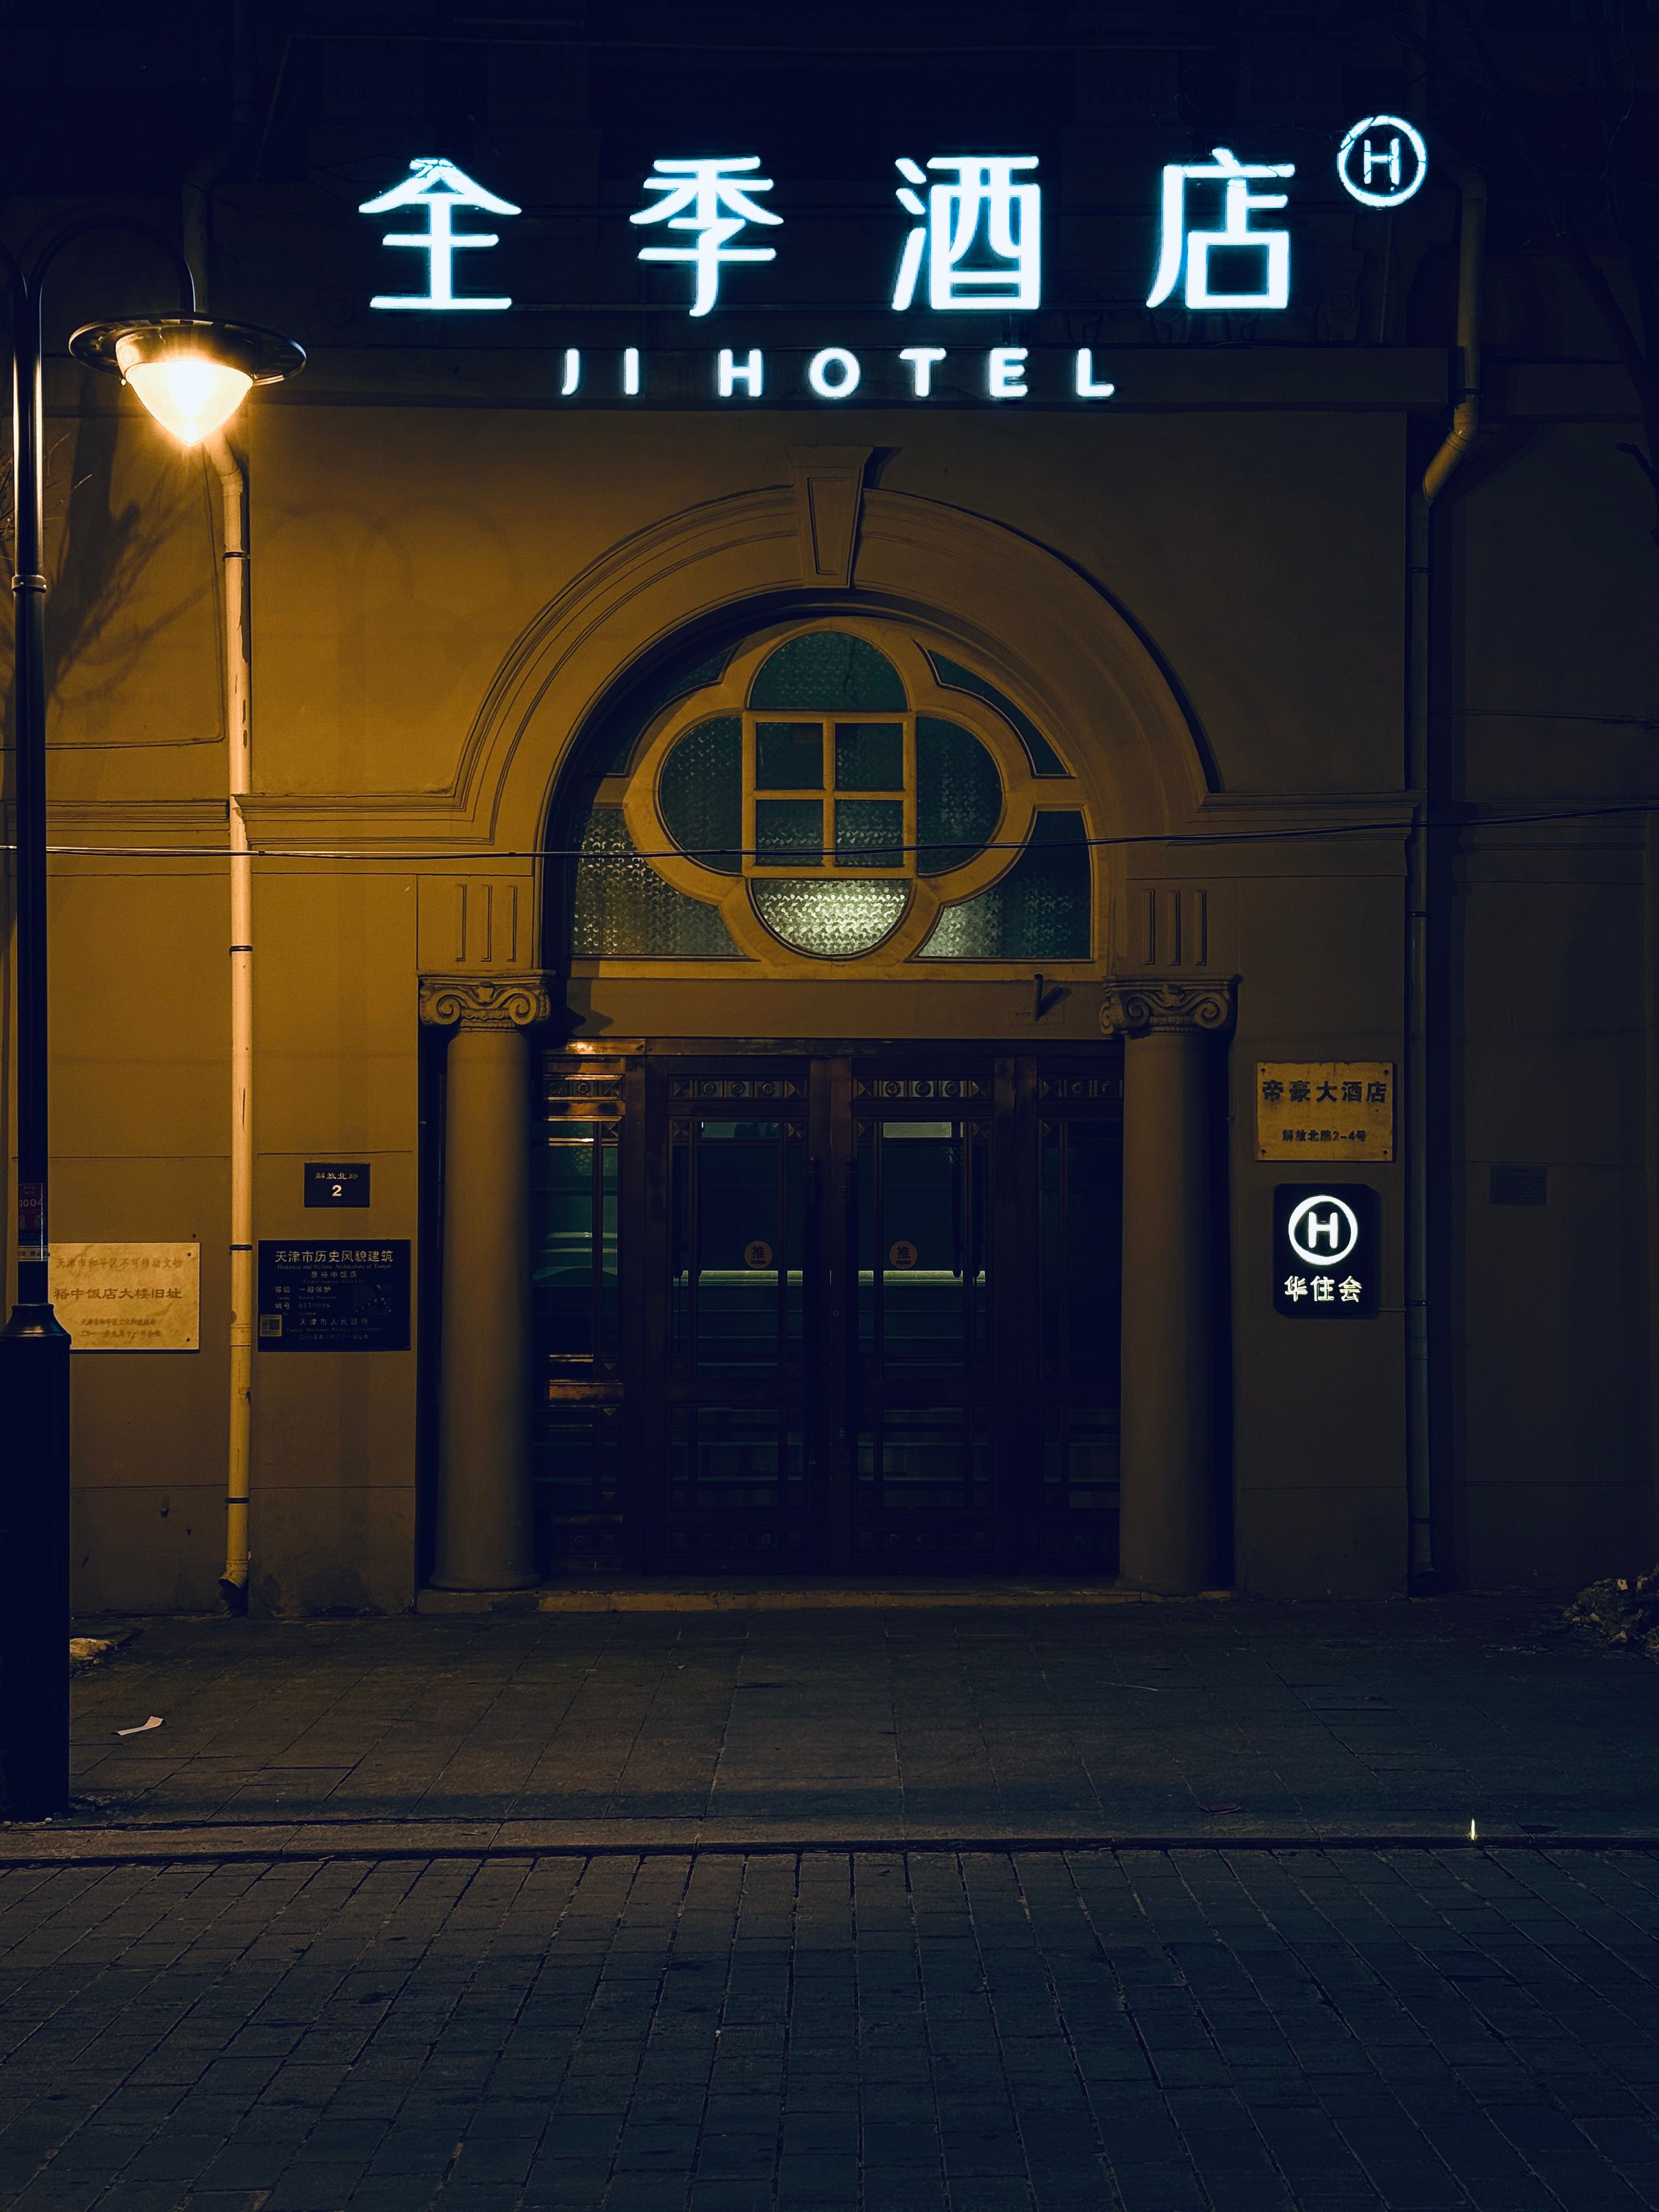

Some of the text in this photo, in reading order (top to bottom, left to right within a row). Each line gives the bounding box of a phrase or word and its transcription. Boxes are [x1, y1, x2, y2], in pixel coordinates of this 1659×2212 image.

[358, 146, 1295, 317] 全季酒店
[561, 348, 1115, 398] JI HOTEL
[1262, 1080, 1387, 1103] 帝豪大酒店
[331, 1184, 342, 1197] 2
[1308, 1211, 1339, 1249] H
[274, 1250, 394, 1263] 天津市历史风貌建筑
[752, 1245, 765, 1259] 推
[896, 1245, 910, 1259] 推
[54, 1288, 183, 1300] 裕中饭店大楼旧址
[1284, 1276, 1363, 1302] 华住会
[299, 1317, 368, 1326] 天津市人民政府
